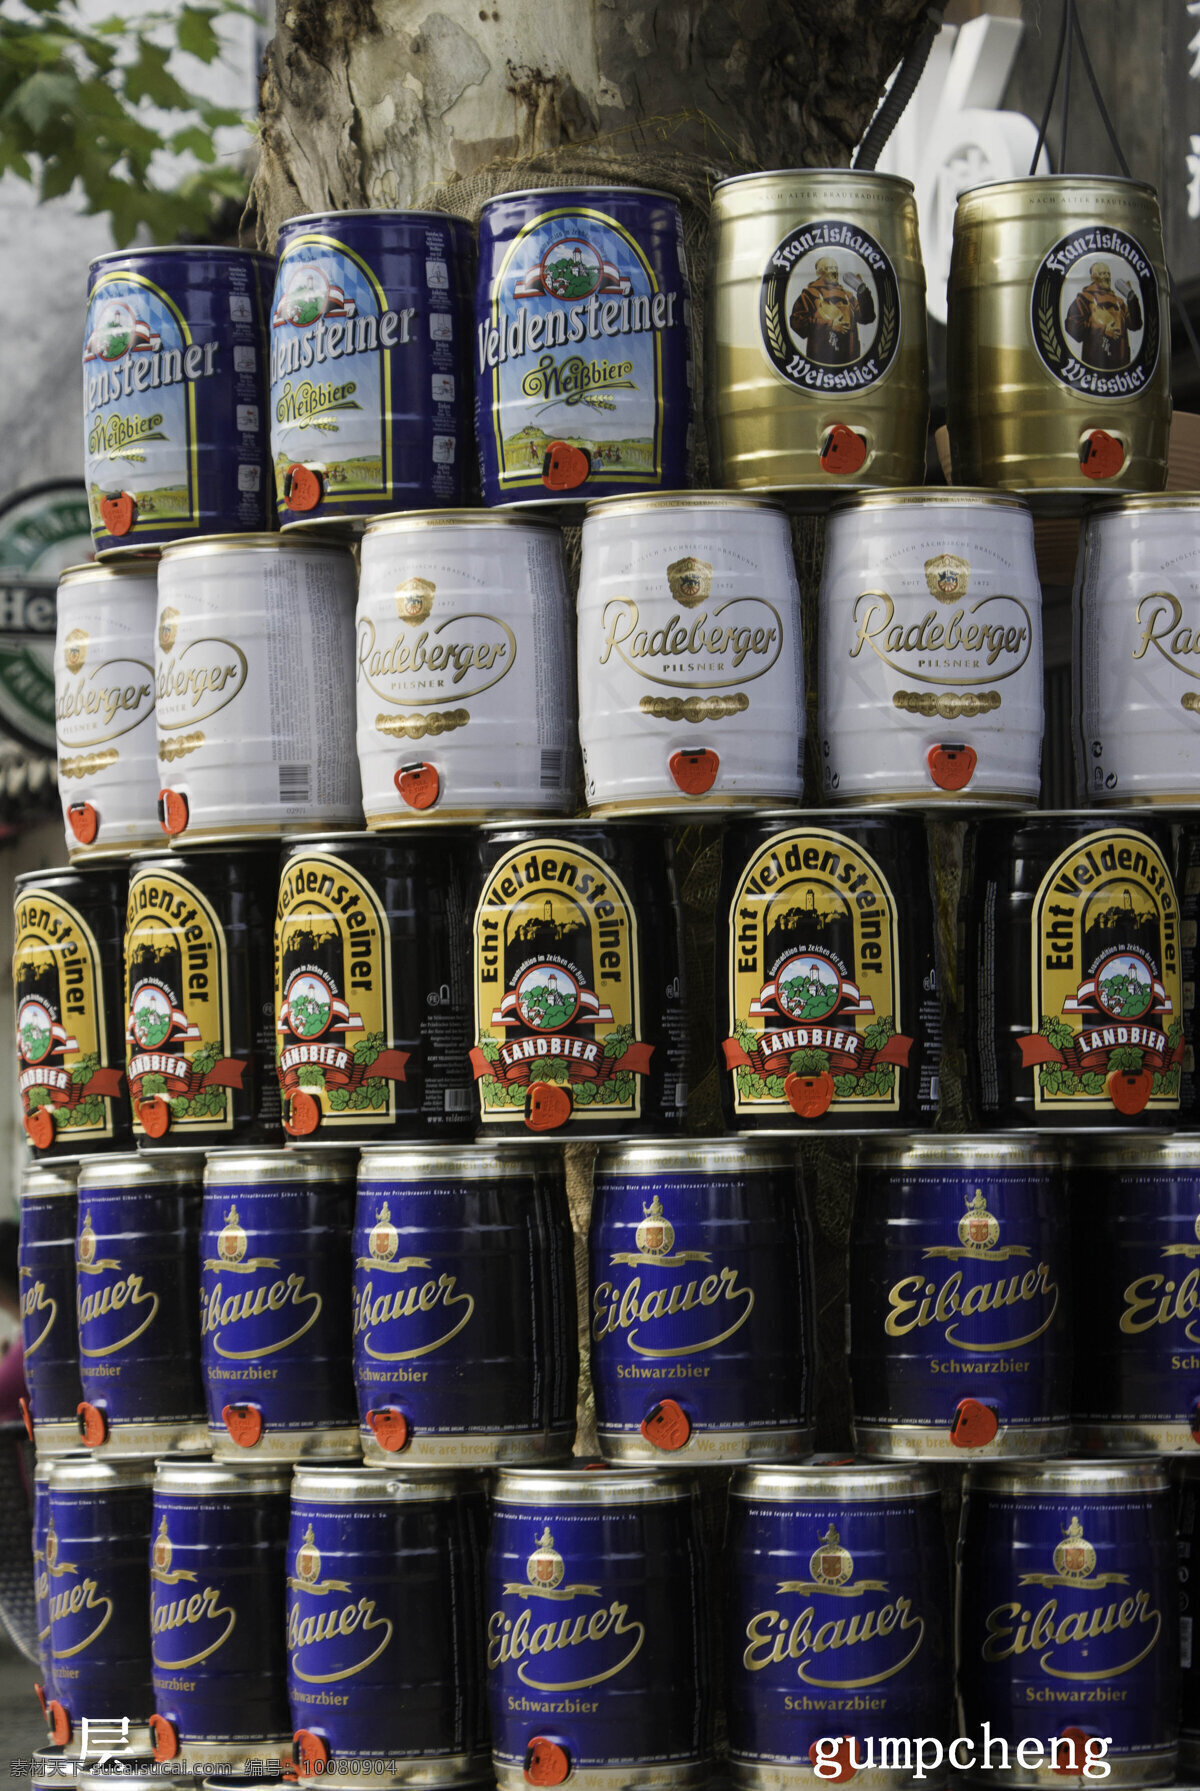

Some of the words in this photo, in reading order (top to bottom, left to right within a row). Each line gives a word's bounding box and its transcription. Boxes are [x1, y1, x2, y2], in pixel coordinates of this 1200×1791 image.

[772, 225, 886, 272] Franziskaner
[1046, 230, 1151, 279] Franziskaner
[478, 287, 677, 375] Veldensteiner
[522, 354, 634, 400] Weißbier
[786, 355, 879, 389] Weissbier
[1061, 358, 1146, 394] Weissbier
[600, 596, 777, 668] Radeberger
[849, 589, 1028, 666] Radeberger
[356, 617, 507, 684] Radeberger
[663, 662, 725, 673] PILSNER
[919, 659, 981, 669] PILSNER
[391, 679, 445, 690] PILSNER
[488, 855, 625, 983] Veldensteiner
[745, 844, 886, 974] Veldensteiner
[1054, 844, 1178, 975] Veldensteiner
[481, 918, 499, 983] Echt
[738, 907, 759, 974] Echt
[808, 943, 830, 956] Zeichen
[1046, 904, 1075, 971] Echt
[546, 953, 568, 967] Zeichen
[281, 1044, 348, 1071] LANDBIER
[502, 1037, 599, 1065] LANDBIER
[761, 1028, 859, 1056] LANDBIER
[1078, 1026, 1165, 1054] LANDBIER
[593, 1266, 748, 1342] Eibauer
[884, 1262, 1055, 1338] Eibauer
[207, 1366, 278, 1380] Schwarzbier
[358, 1368, 429, 1382] Schwarzbier
[616, 1364, 711, 1379] Schwarzbier
[930, 1359, 1030, 1374] Schwarzbier
[417, 1443, 440, 1456] We
[440, 1445, 457, 1456] are
[697, 1439, 717, 1451] We
[719, 1440, 738, 1451] are
[487, 1600, 638, 1671] Eibauer
[742, 1595, 920, 1672] Eibauer
[982, 1588, 1156, 1663] Eibauer
[508, 1695, 599, 1713] Schwarzbier
[784, 1695, 887, 1711] Schwarzbier
[1026, 1686, 1128, 1702] Schwarzbier
